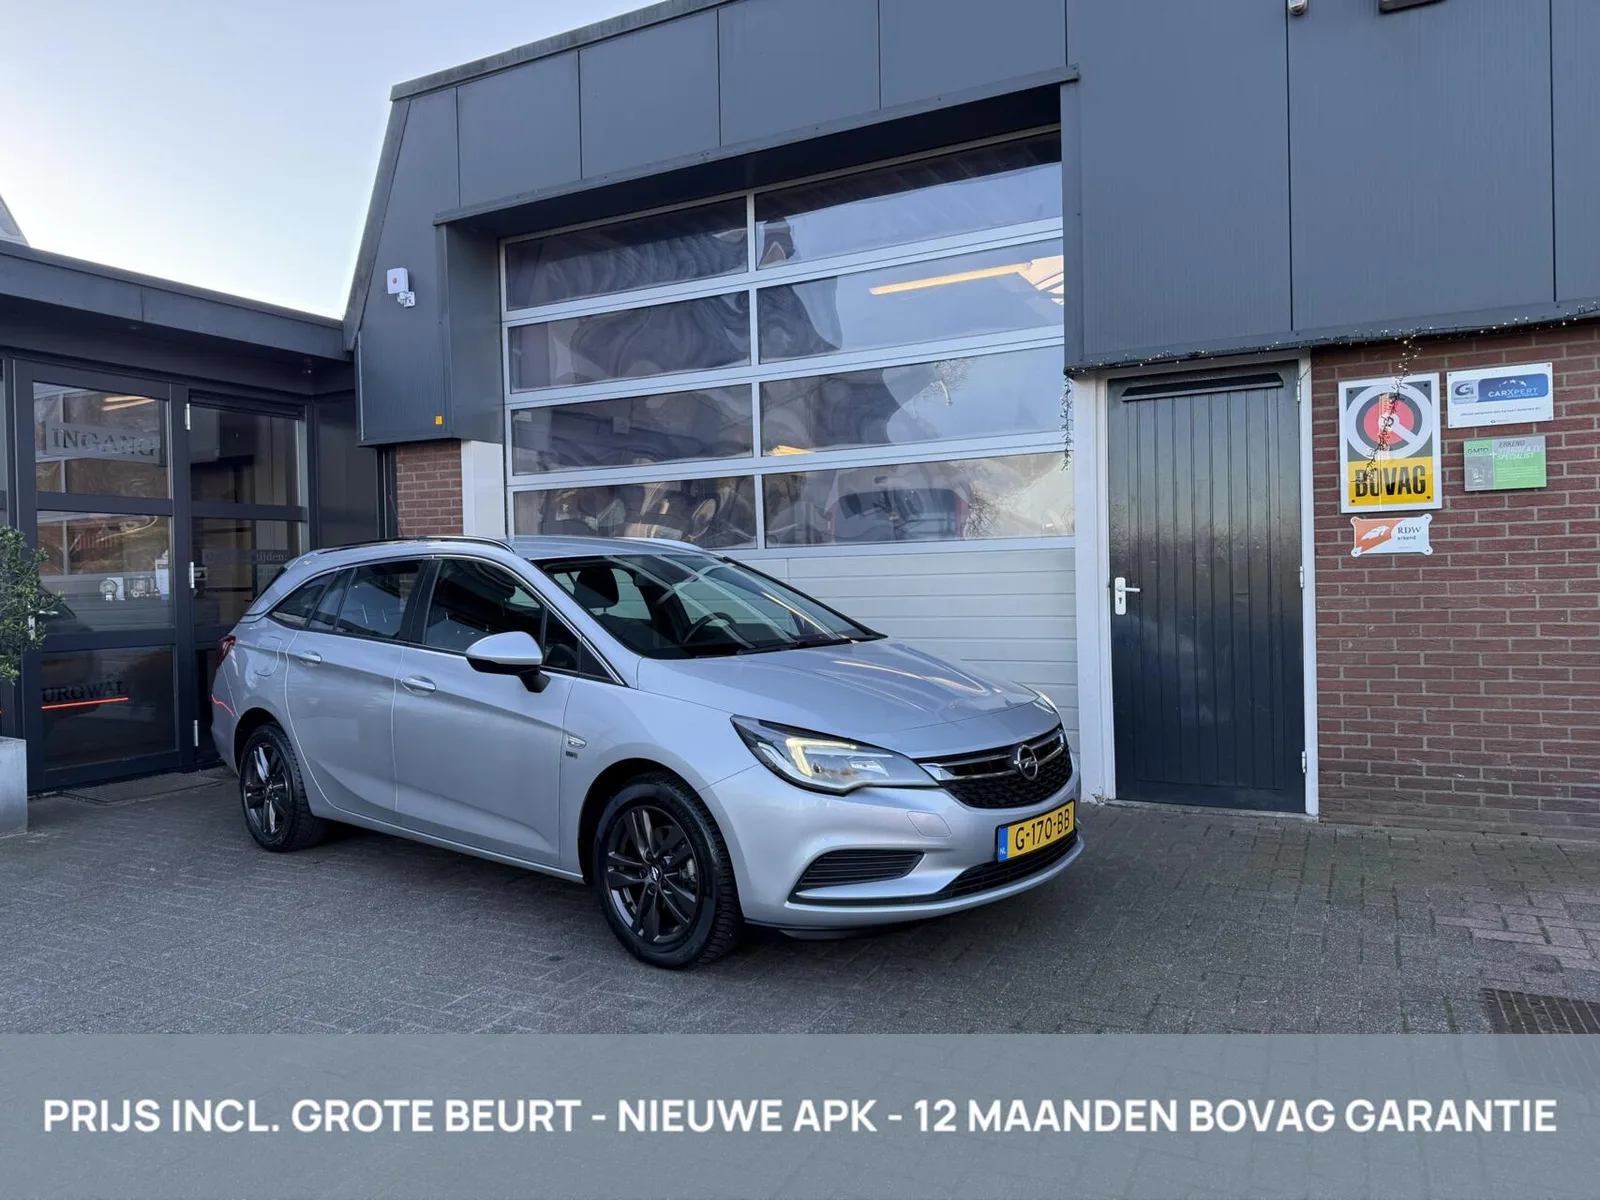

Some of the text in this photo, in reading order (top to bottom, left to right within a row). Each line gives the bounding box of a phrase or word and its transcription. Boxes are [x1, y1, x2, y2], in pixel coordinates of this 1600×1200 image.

[1487, 387, 1539, 398] CARXPERT
[51, 427, 156, 457] INGANG
[1354, 465, 1427, 498] BOVAG
[1397, 525, 1421, 534] RDW
[1015, 808, 1070, 851] G-170-BB
